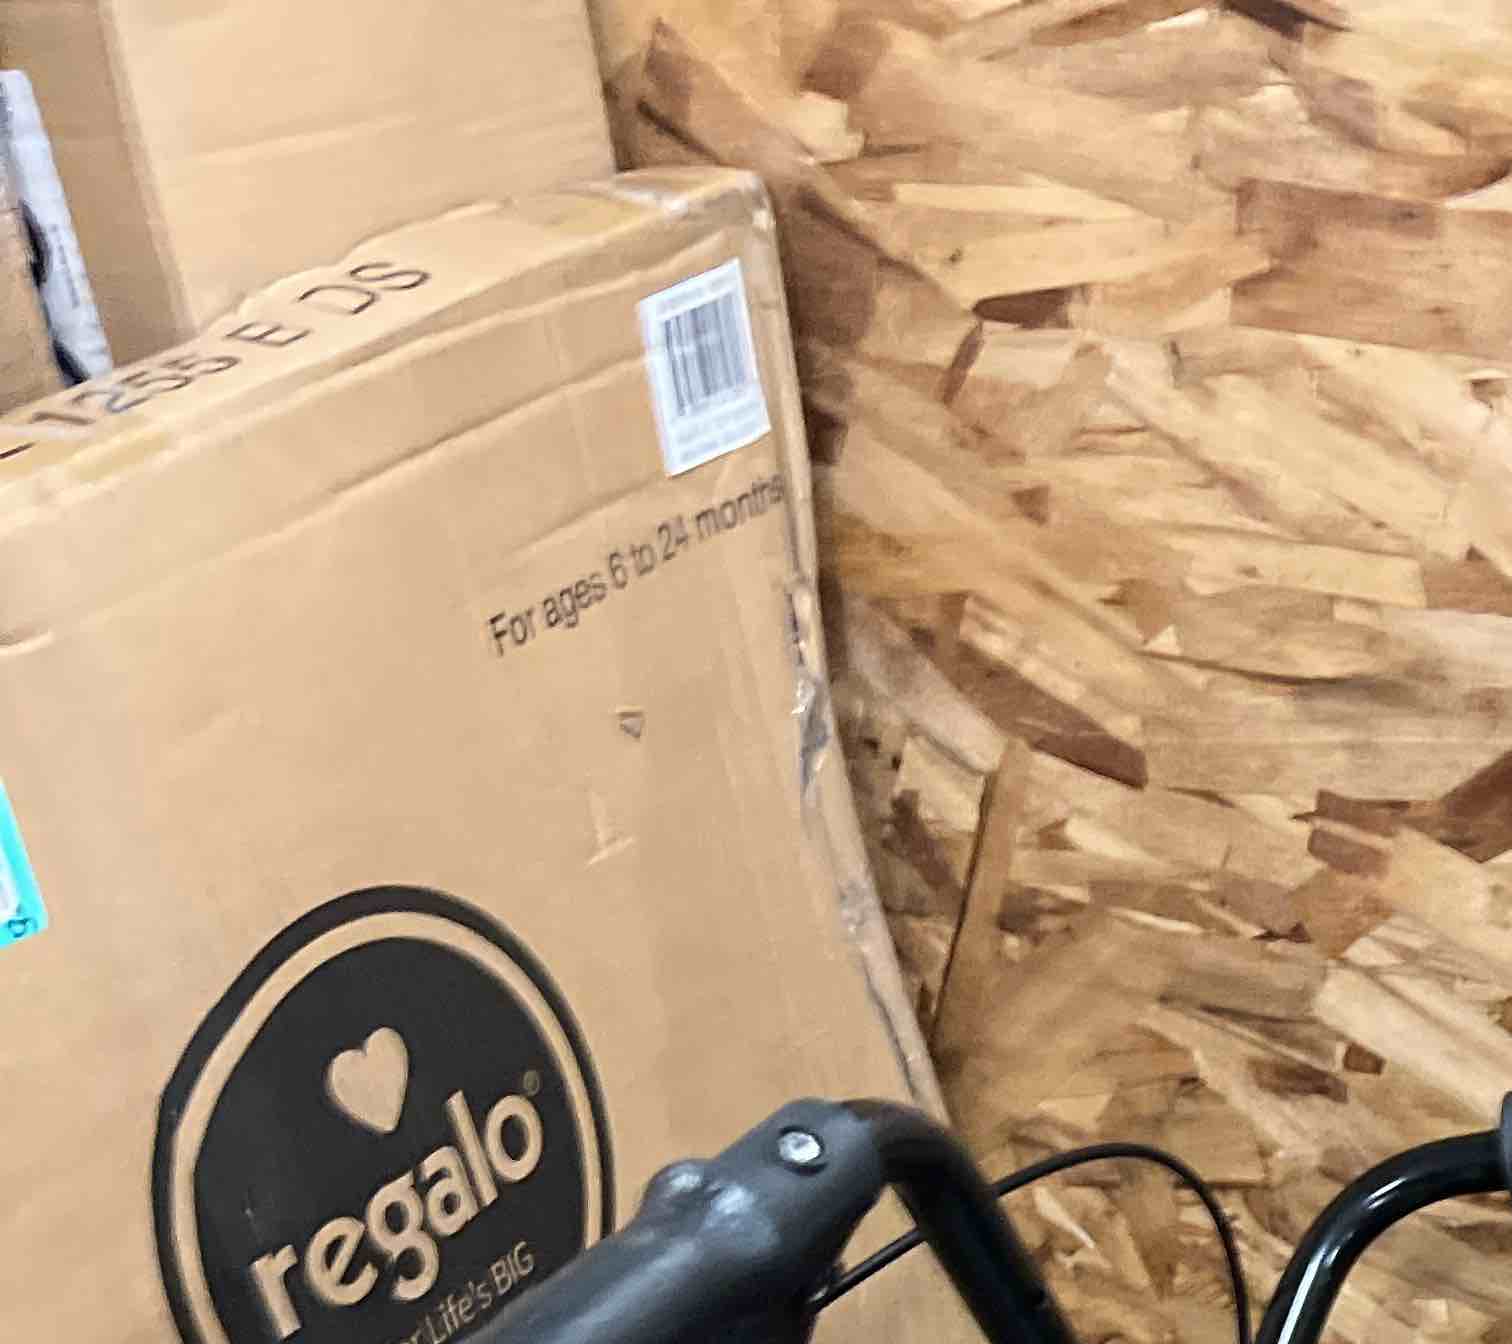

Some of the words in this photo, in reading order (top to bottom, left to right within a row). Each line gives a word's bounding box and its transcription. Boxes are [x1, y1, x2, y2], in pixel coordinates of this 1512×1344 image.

[32, 354, 243, 427] 1255
[295, 260, 433, 316] DS
[487, 610, 538, 658] For
[542, 570, 608, 629] ages
[608, 551, 628, 590] 6
[630, 543, 656, 577] to
[657, 514, 689, 561] 24
[249, 1090, 544, 1341] regalo
[492, 1239, 537, 1297] BIG
